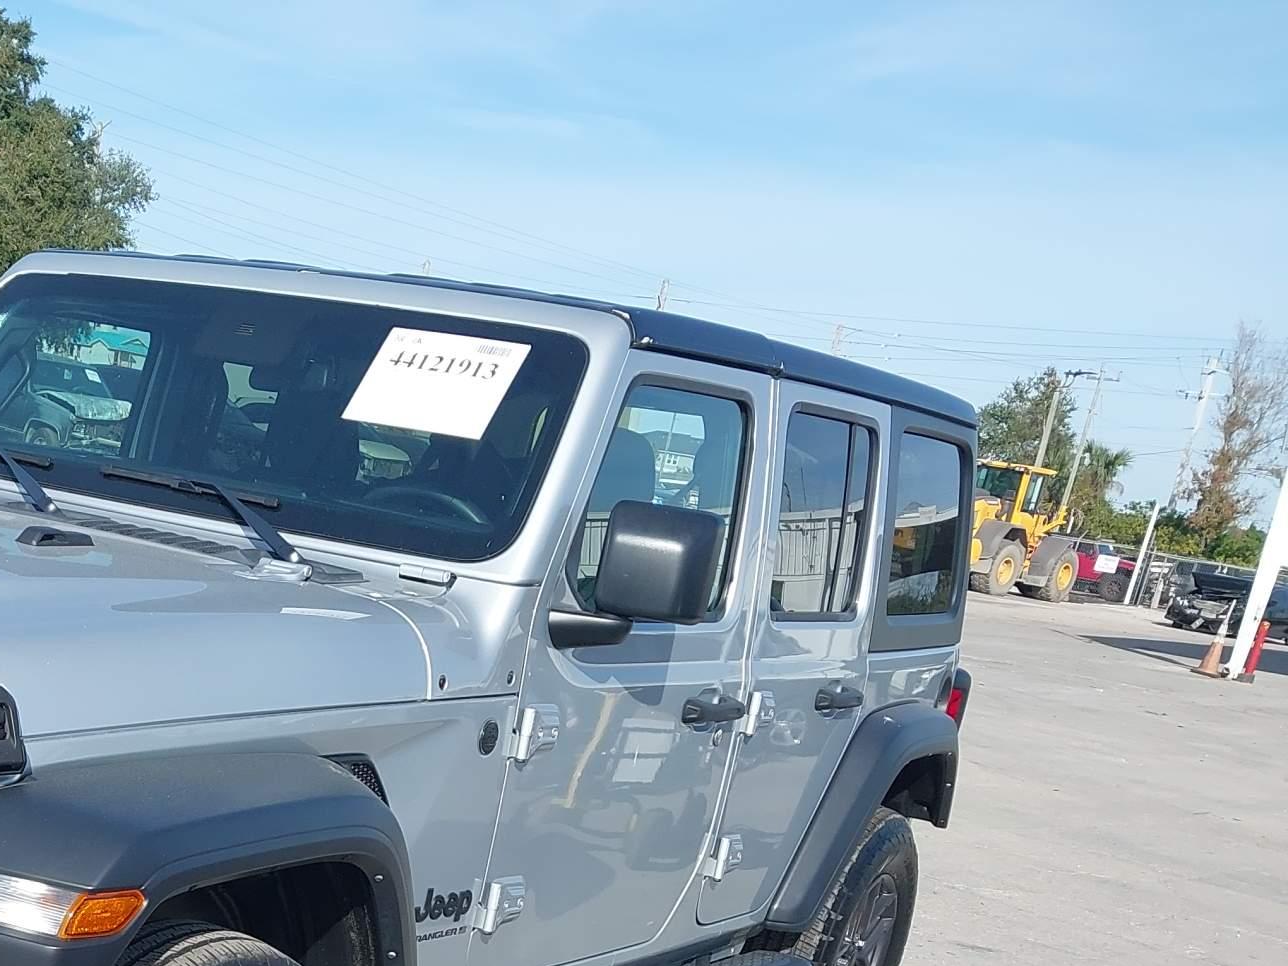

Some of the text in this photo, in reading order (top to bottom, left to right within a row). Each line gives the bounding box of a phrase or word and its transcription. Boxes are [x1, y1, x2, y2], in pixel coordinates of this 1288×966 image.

[390, 350, 500, 380] 44121913
[415, 888, 473, 923] Jeep
[415, 927, 458, 943] RANGLER
